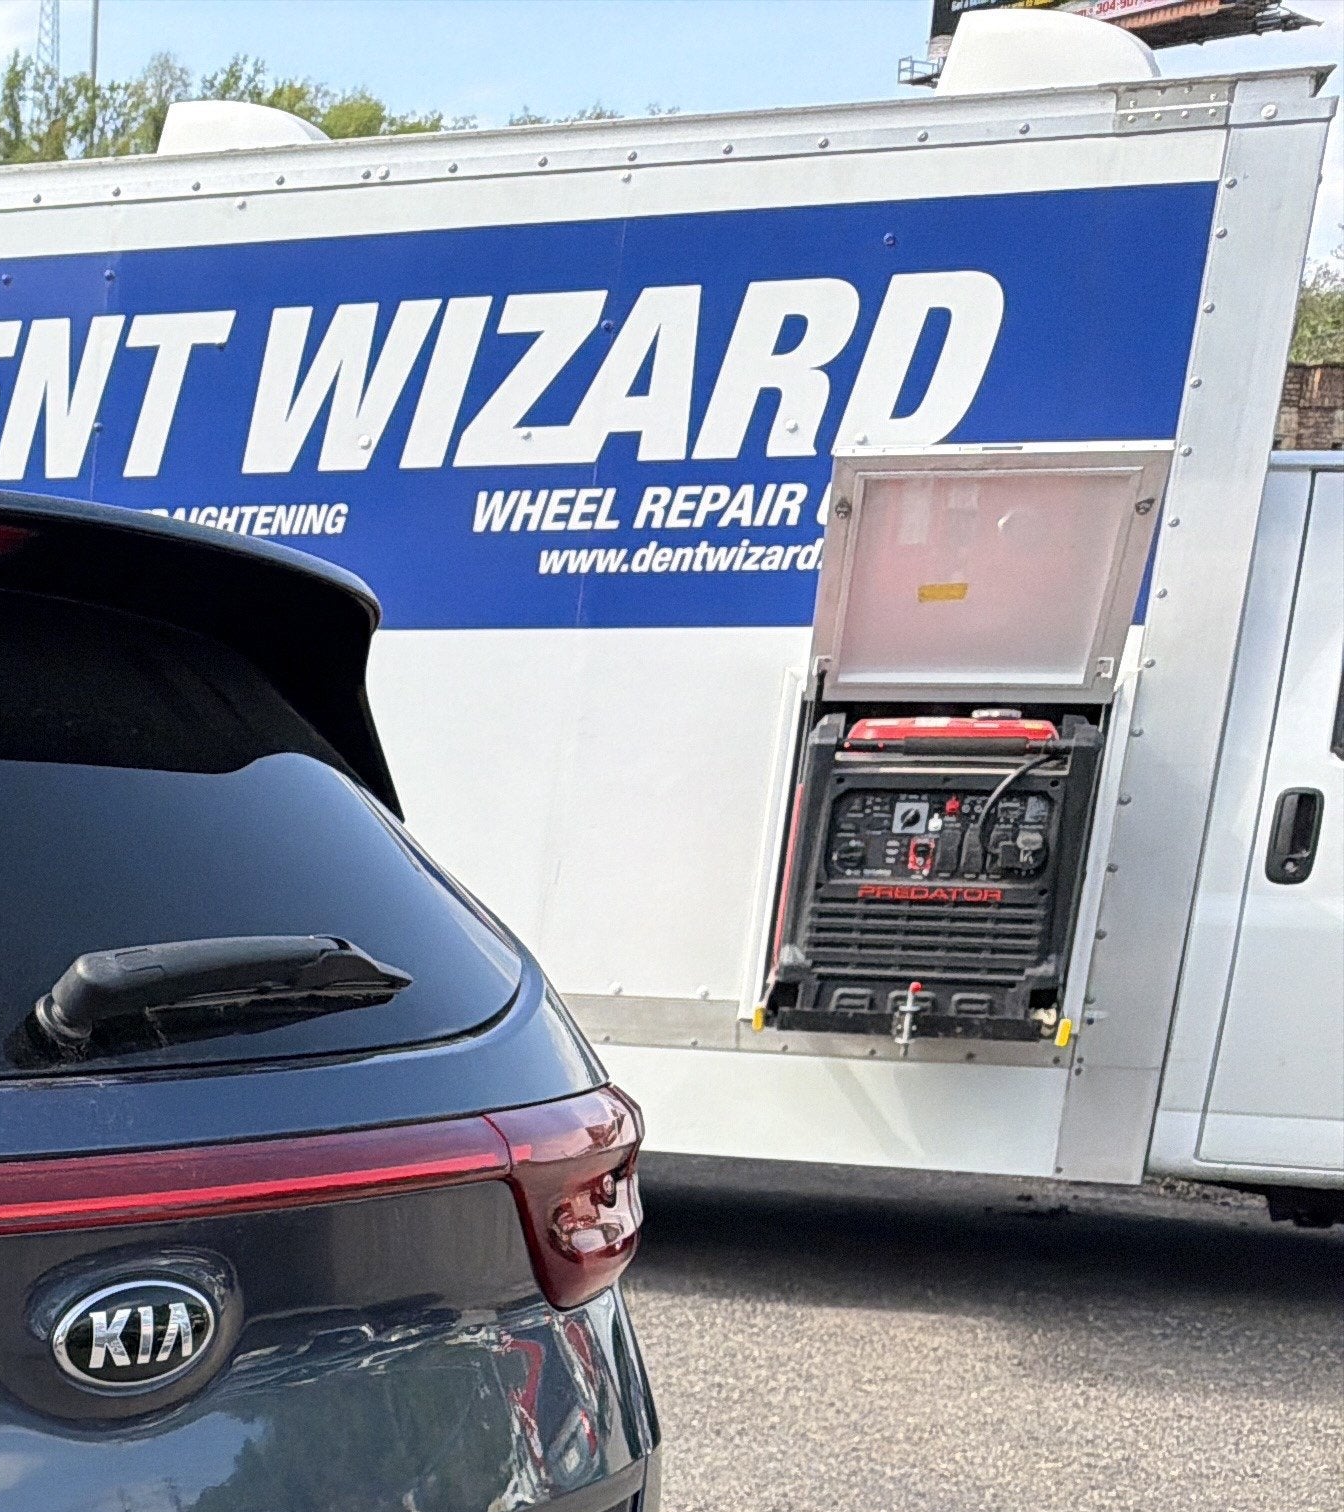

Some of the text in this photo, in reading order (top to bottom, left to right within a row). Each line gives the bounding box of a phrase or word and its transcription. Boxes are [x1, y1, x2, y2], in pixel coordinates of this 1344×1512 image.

[241, 270, 1005, 473] WIZARD
[134, 502, 349, 536] IGHTENING
[473, 487, 620, 533] WHEEL
[633, 483, 808, 529] REPAIR
[858, 885, 1003, 901] PREDATOR
[88, 1302, 193, 1369] KIA
